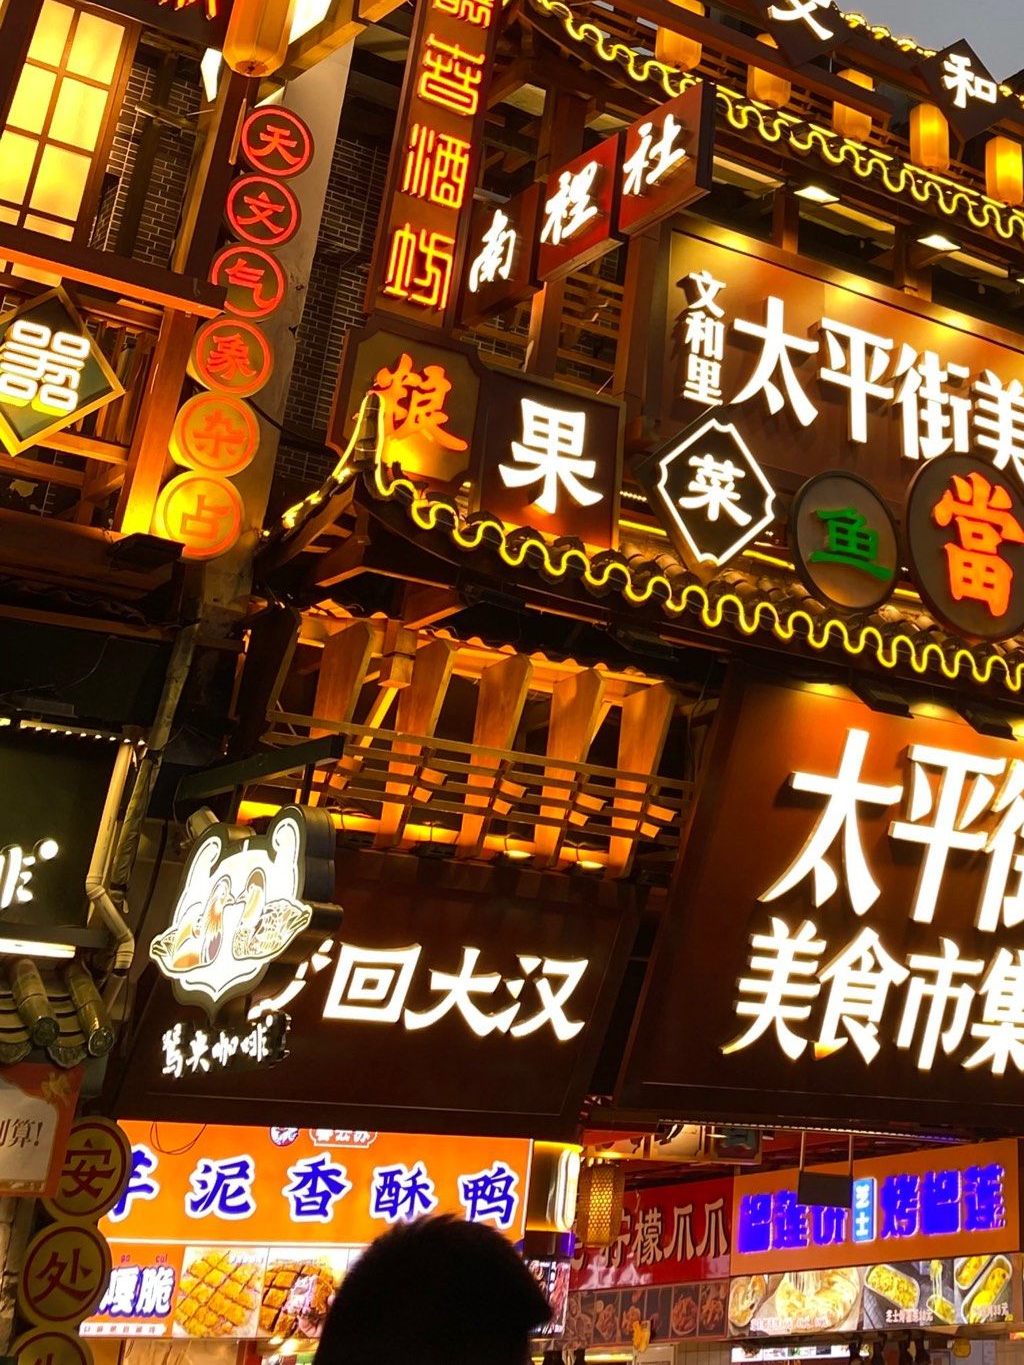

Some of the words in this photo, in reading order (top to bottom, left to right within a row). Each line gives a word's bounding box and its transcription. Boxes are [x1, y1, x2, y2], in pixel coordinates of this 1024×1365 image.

[181, 123, 303, 541] 天文气象杂占
[683, 272, 727, 406] 文和里
[498, 398, 604, 515] 果
[678, 453, 753, 527] 菜
[809, 506, 893, 581] 鱼
[108, 1145, 520, 1226] 芋泥香酥鸭
[854, 1183, 873, 1237] 芝士
[571, 1197, 729, 1271] 柠檬爪爪
